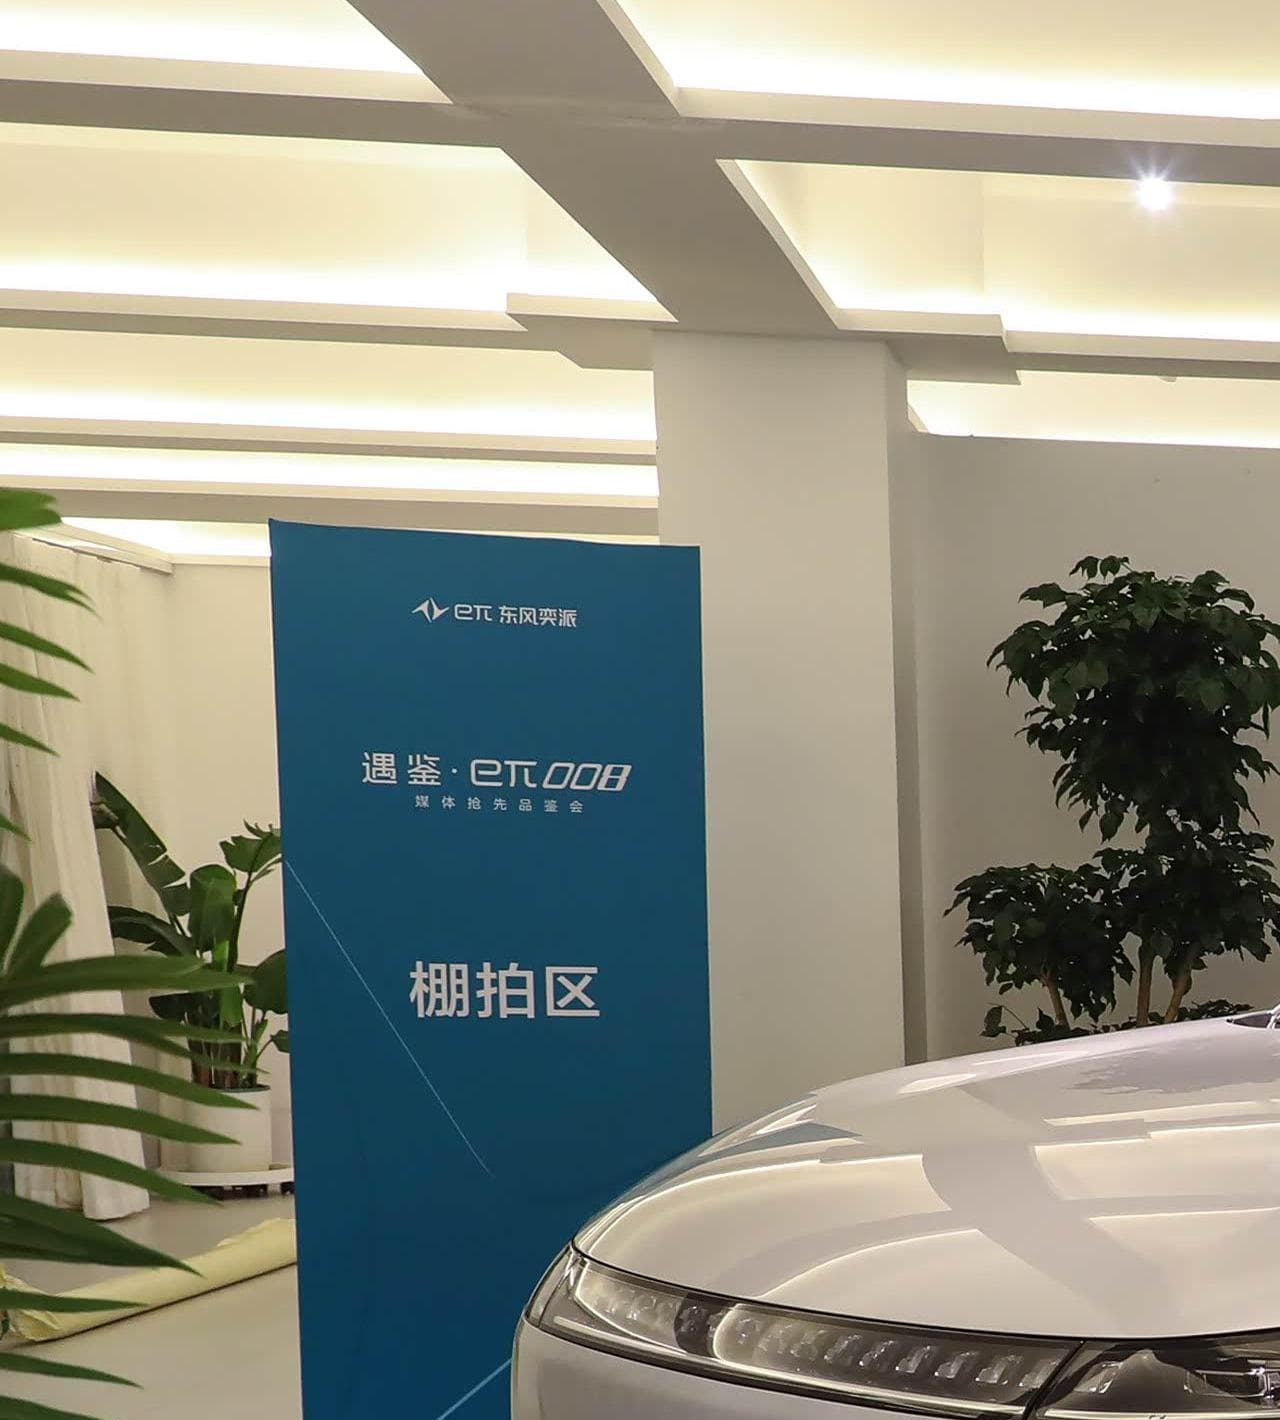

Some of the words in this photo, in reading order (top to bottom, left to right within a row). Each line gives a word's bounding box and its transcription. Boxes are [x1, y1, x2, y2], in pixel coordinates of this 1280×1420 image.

[498, 605, 578, 628] 东风奕派
[414, 795, 584, 814] 媒体抢先品鉴会
[409, 960, 600, 1019] 棚拍区
